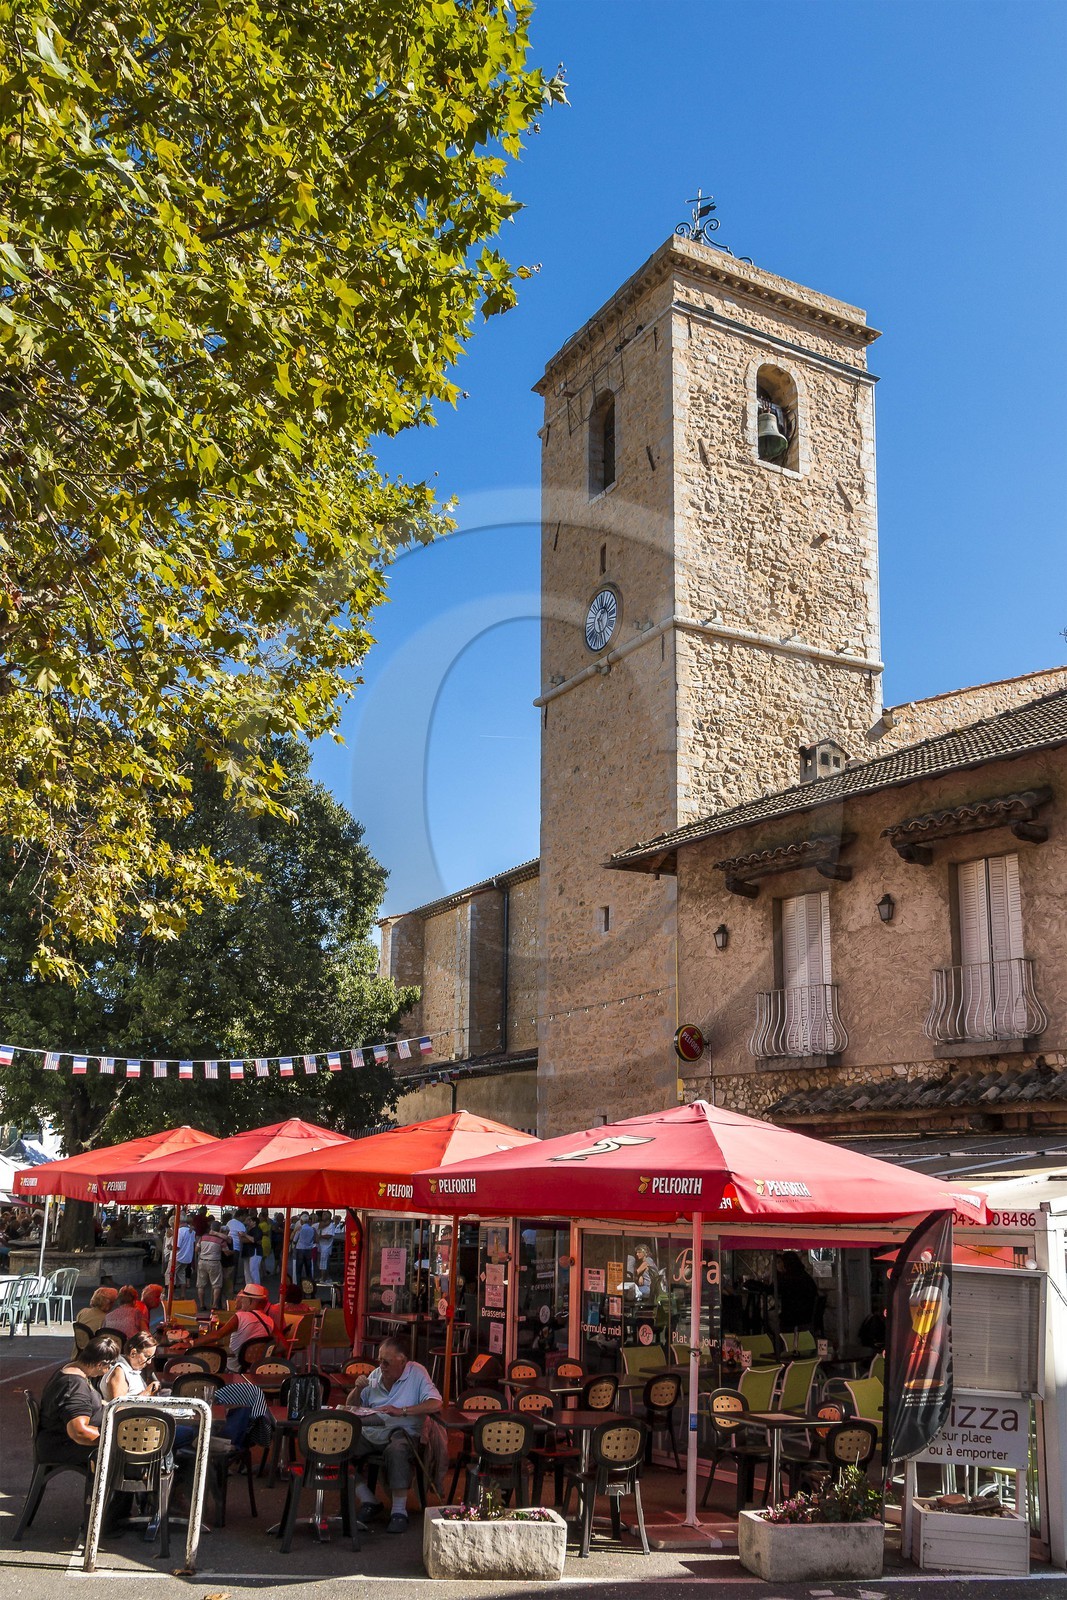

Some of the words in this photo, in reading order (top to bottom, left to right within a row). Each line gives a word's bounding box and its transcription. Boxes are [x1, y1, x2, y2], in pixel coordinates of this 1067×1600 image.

[107, 1181, 127, 1191] PELFORTH
[242, 1182, 271, 1195] PELFORTH
[439, 1178, 476, 1193] PELFORTH
[652, 1177, 702, 1195] PELFORTH
[765, 1180, 812, 1197] PELFORTH
[481, 1308, 506, 1319] Brasserie
[581, 1321, 607, 1334] Formule
[607, 1325, 622, 1336] midi
[672, 1331, 687, 1344] Plat
[951, 1398, 1019, 1432] izza
[942, 1432, 958, 1441] sur
[961, 1431, 992, 1444] place
[929, 1446, 943, 1455] ou
[946, 1444, 952, 1456] à
[956, 1447, 1009, 1461] emporter
